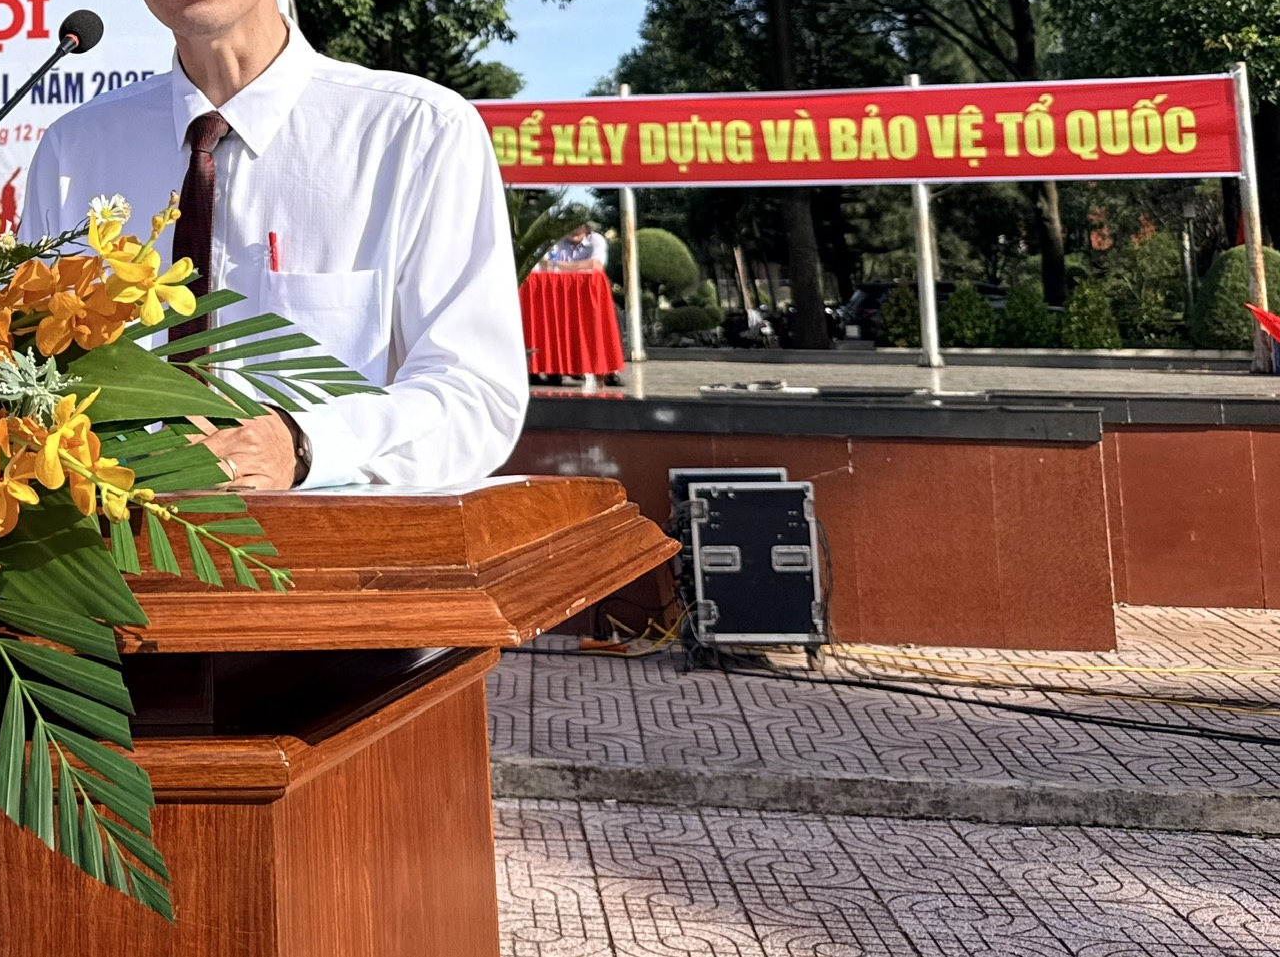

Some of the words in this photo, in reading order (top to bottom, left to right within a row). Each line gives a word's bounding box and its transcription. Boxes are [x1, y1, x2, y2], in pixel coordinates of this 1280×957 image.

[2, 73, 9, 104] I
[30, 67, 85, 105] NĂM
[15, 124, 32, 141] 12
[550, 115, 629, 166] XÂY
[638, 114, 754, 173] DỰNG
[760, 109, 822, 162] VÀ
[829, 104, 918, 161] BẢO
[925, 104, 987, 167] VỆ
[995, 93, 1055, 158] TỔ
[1065, 94, 1198, 160] QUỐC
